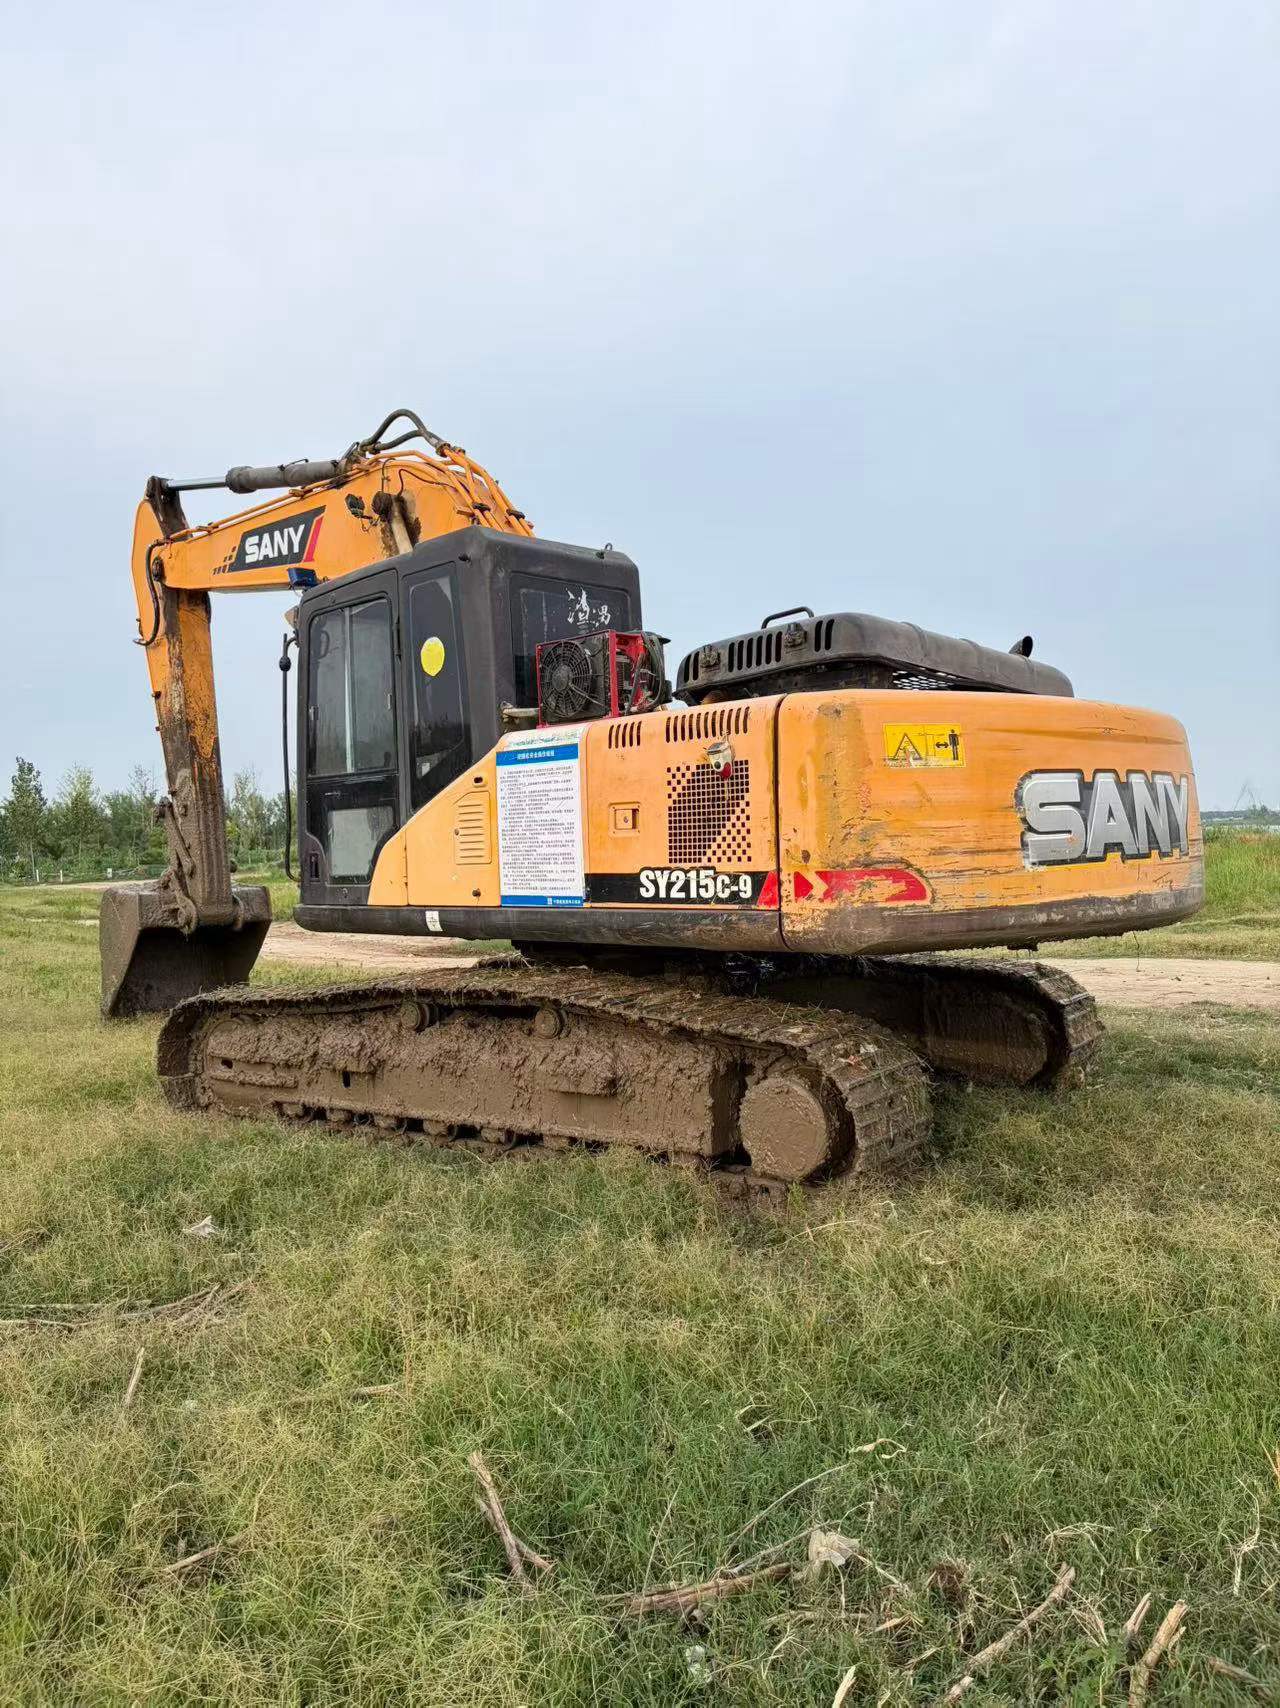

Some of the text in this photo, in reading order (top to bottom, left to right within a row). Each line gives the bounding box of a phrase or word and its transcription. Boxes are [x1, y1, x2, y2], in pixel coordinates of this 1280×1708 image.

[245, 524, 306, 564] SANY
[1019, 772, 1189, 865] SANY
[639, 869, 753, 899] SY215C-9
